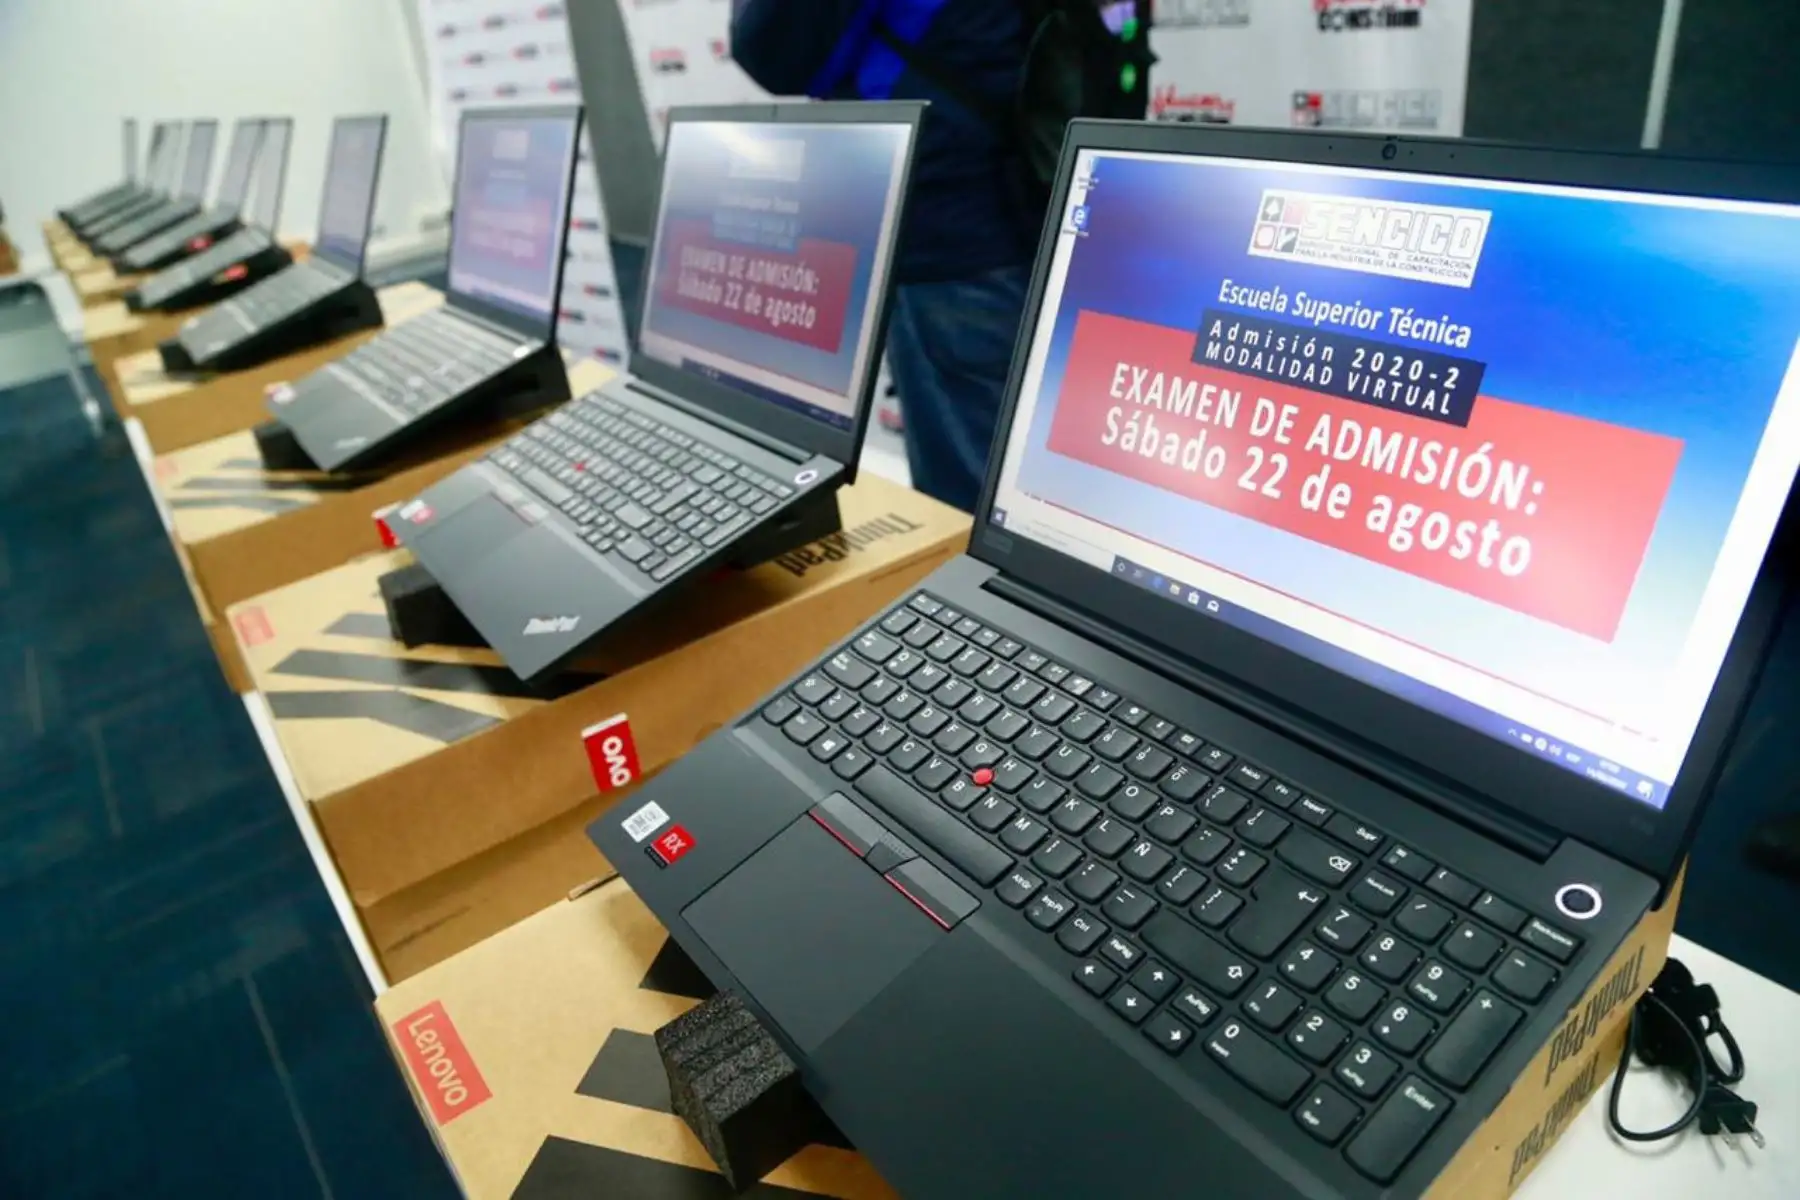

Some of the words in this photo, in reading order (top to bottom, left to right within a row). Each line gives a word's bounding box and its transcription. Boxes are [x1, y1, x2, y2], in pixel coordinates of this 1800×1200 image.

[1300, 201, 1485, 260] SENCICO
[723, 281, 744, 310] 22
[743, 285, 763, 316] de
[763, 296, 817, 329] agosto
[1219, 278, 1289, 316] Escuela
[1291, 291, 1384, 332] Superior
[1388, 306, 1472, 349] Técnica
[1209, 319, 1334, 363] Admisión
[1351, 347, 1460, 390] 2020-2
[1205, 340, 1333, 386] MODALIDAD
[1347, 372, 1451, 415] VIRTUAL
[1109, 361, 1242, 430] EXAMEN
[1249, 397, 1299, 445] DE
[1305, 412, 1546, 517] ADMISIÓN:
[1100, 405, 1226, 480] Sábado
[1237, 445, 1289, 499] 22
[1299, 463, 1352, 520] de
[1365, 493, 1531, 578] agosto
[922, 665, 935, 676] W
[874, 679, 884, 687] A
[945, 679, 958, 690] E
[896, 692, 908, 702] S
[972, 695, 984, 705] R
[853, 708, 866, 719] Z
[921, 708, 933, 718] D
[1002, 711, 1012, 720] T
[877, 725, 890, 735] X
[947, 724, 959, 732] F
[1030, 728, 1041, 737] Y
[902, 742, 915, 752] C
[975, 743, 988, 753] G
[1059, 746, 1072, 757] U
[930, 758, 941, 769] V
[1003, 760, 1017, 771] H
[1033, 780, 1046, 789] J
[1125, 786, 1139, 797] O
[984, 797, 998, 808] N
[1065, 798, 1079, 811] K
[1160, 806, 1174, 815] P
[1015, 818, 1031, 830] M
[1099, 820, 1109, 832] L
[661, 832, 688, 855] RX
[1335, 909, 1350, 922] 7
[1074, 918, 1090, 932] Ctrl
[1380, 937, 1394, 951] 8
[1300, 949, 1314, 960] 4
[1428, 966, 1443, 980] 9
[1345, 976, 1360, 990] 5
[1266, 987, 1277, 998] 1
[1392, 1007, 1408, 1021] 6
[1306, 1016, 1323, 1031] 2
[1225, 1024, 1240, 1038] 0
[407, 1013, 468, 1108] Lenovo
[1355, 1048, 1371, 1064] 3
